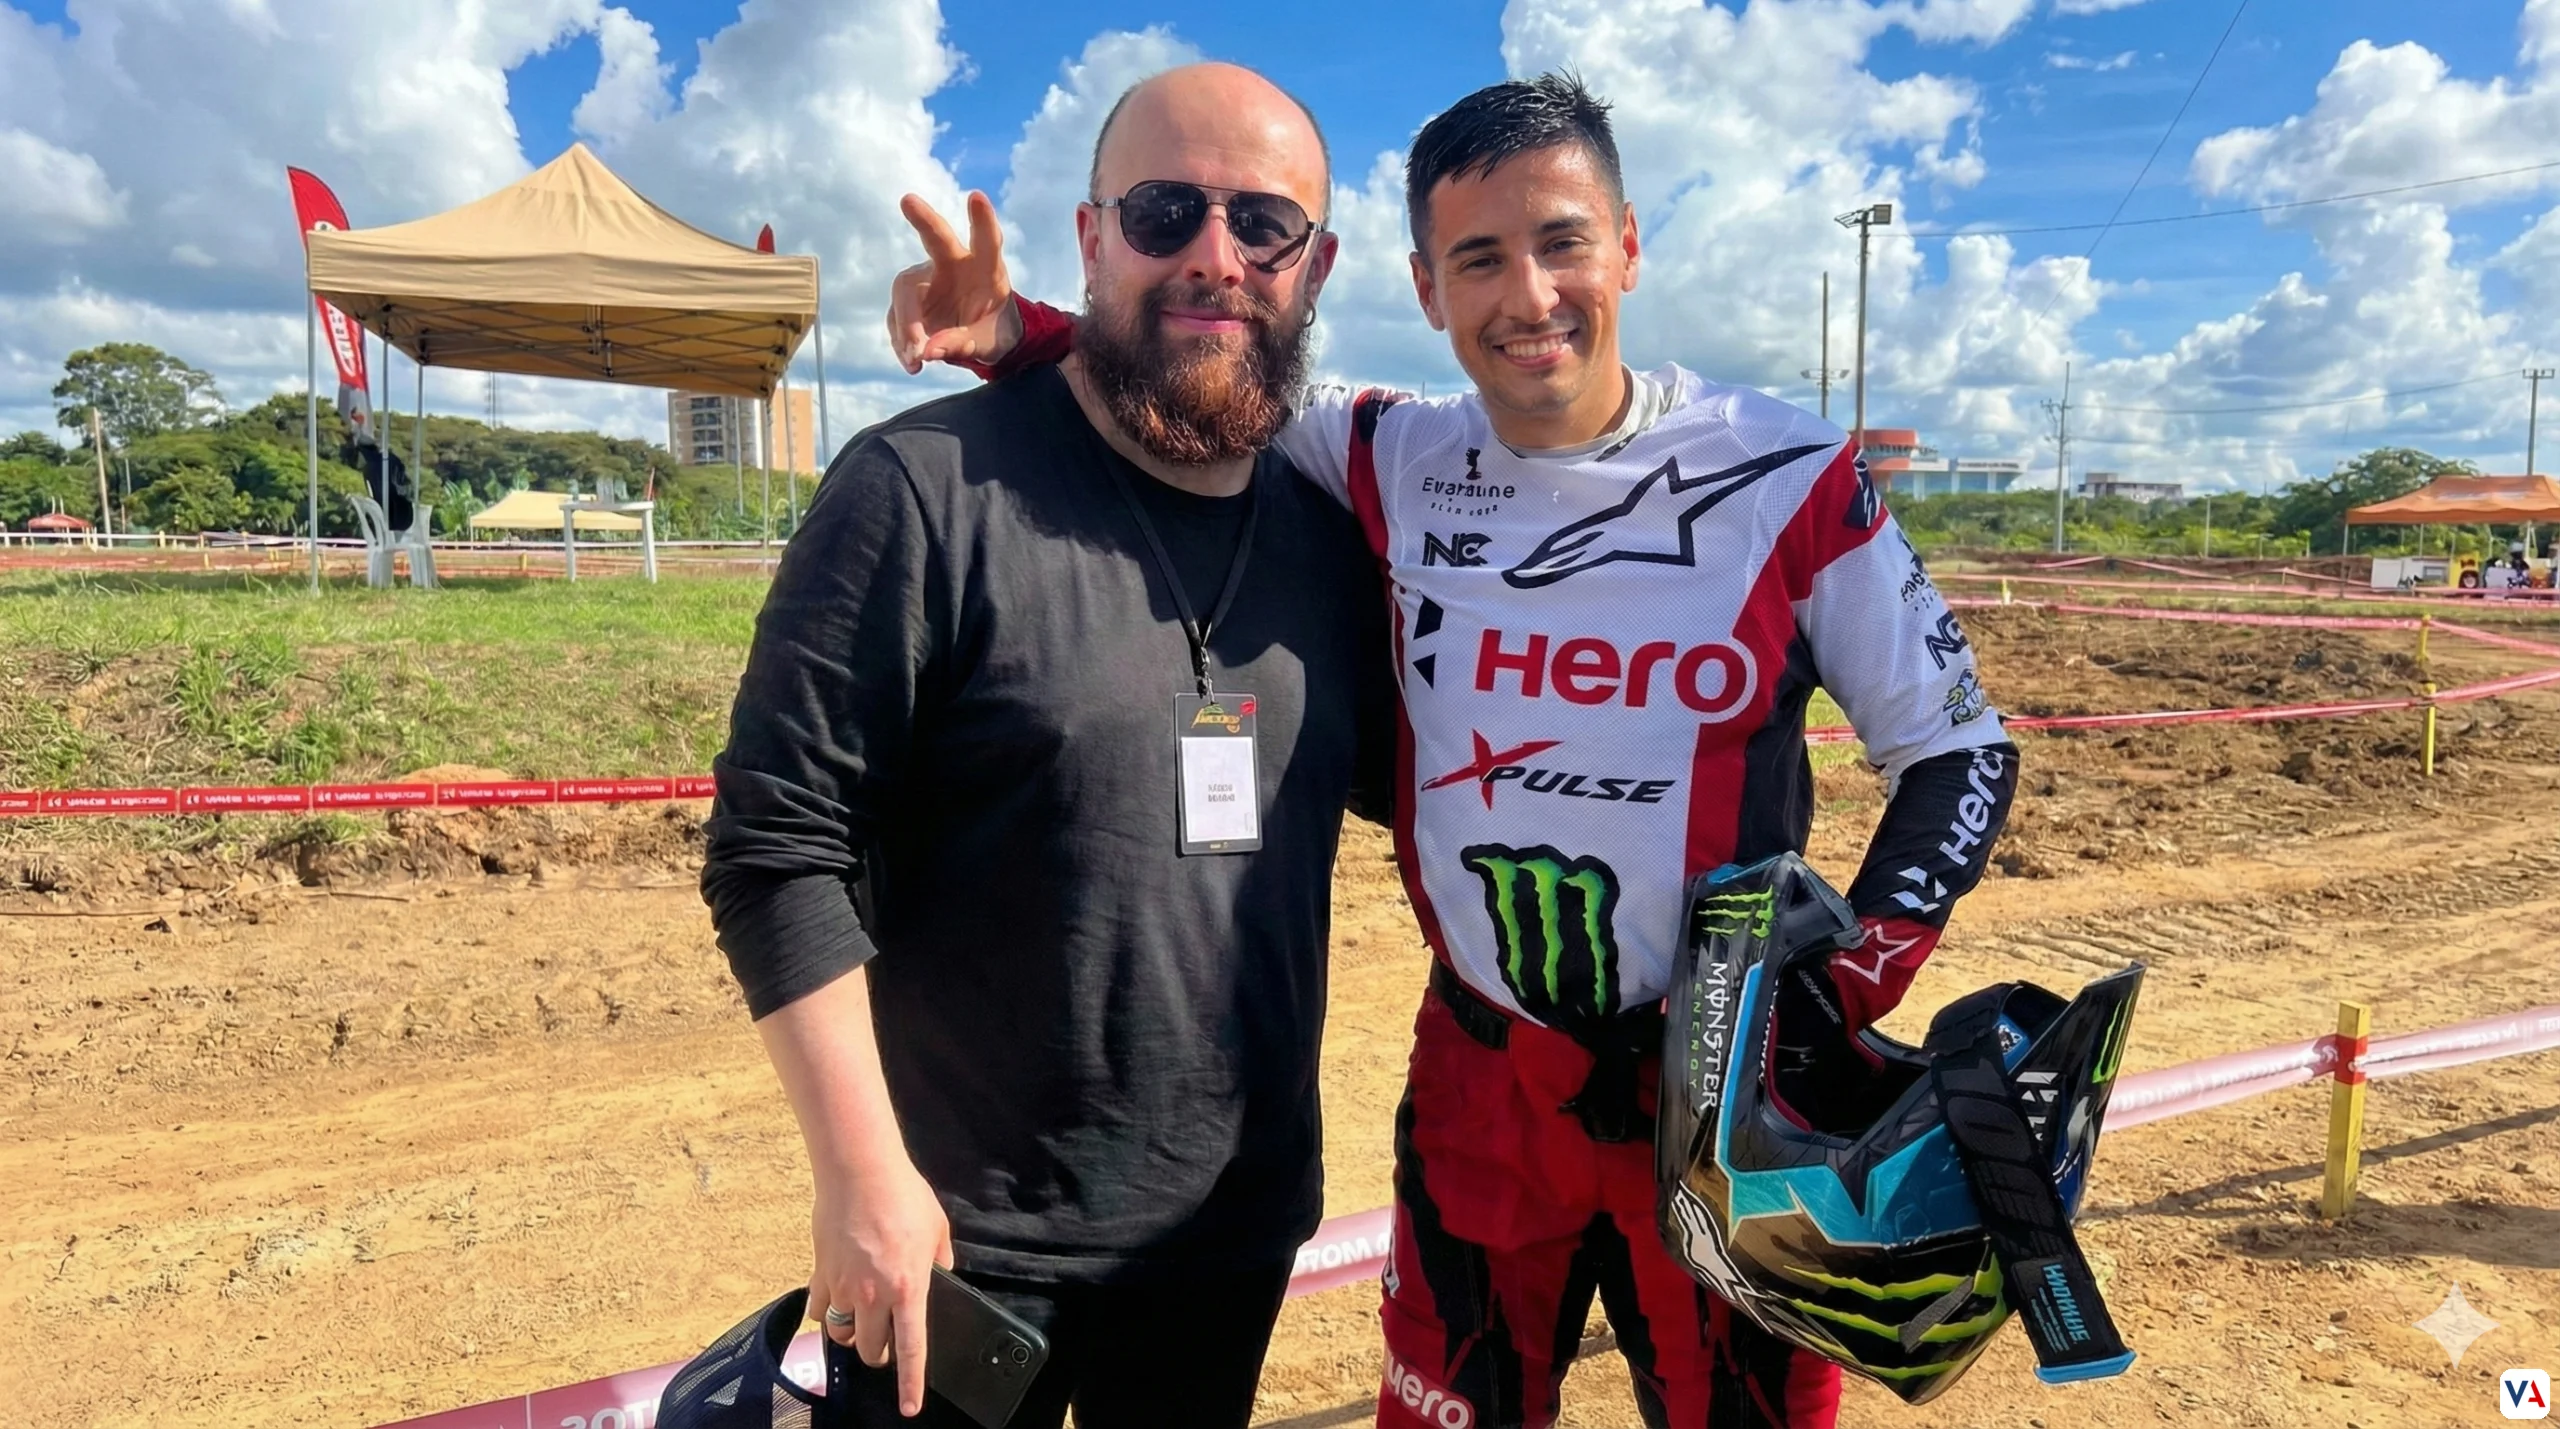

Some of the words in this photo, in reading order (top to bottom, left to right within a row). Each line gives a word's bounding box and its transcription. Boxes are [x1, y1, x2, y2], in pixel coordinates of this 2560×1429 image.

[1475, 628, 1748, 714] Hero
[1938, 748, 2004, 866] Hero
[1700, 962, 1731, 1110] MONSTER
